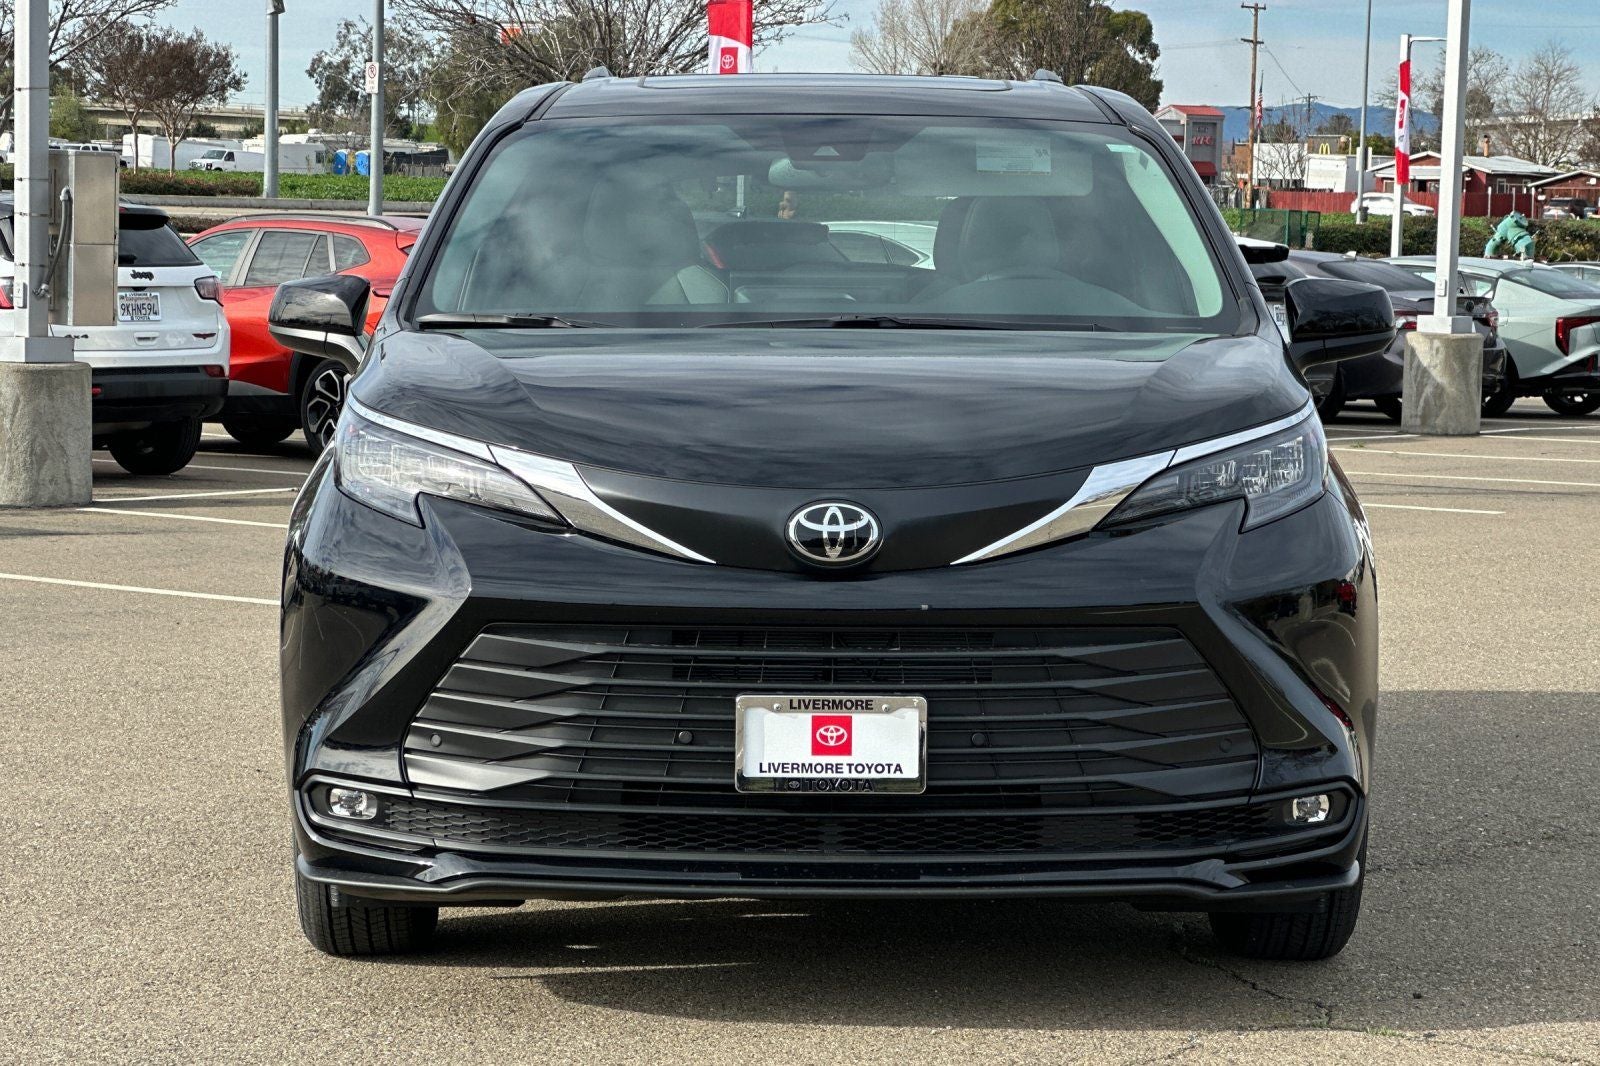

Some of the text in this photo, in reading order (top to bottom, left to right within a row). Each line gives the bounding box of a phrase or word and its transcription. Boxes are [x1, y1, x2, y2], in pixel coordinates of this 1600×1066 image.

[130, 269, 154, 281] Jeep
[120, 303, 160, 316] 9KHN594
[789, 698, 874, 711] LIVERMORE
[759, 762, 903, 774] LIVERMORE TOYOTA
[805, 778, 874, 792] TOYOTA
